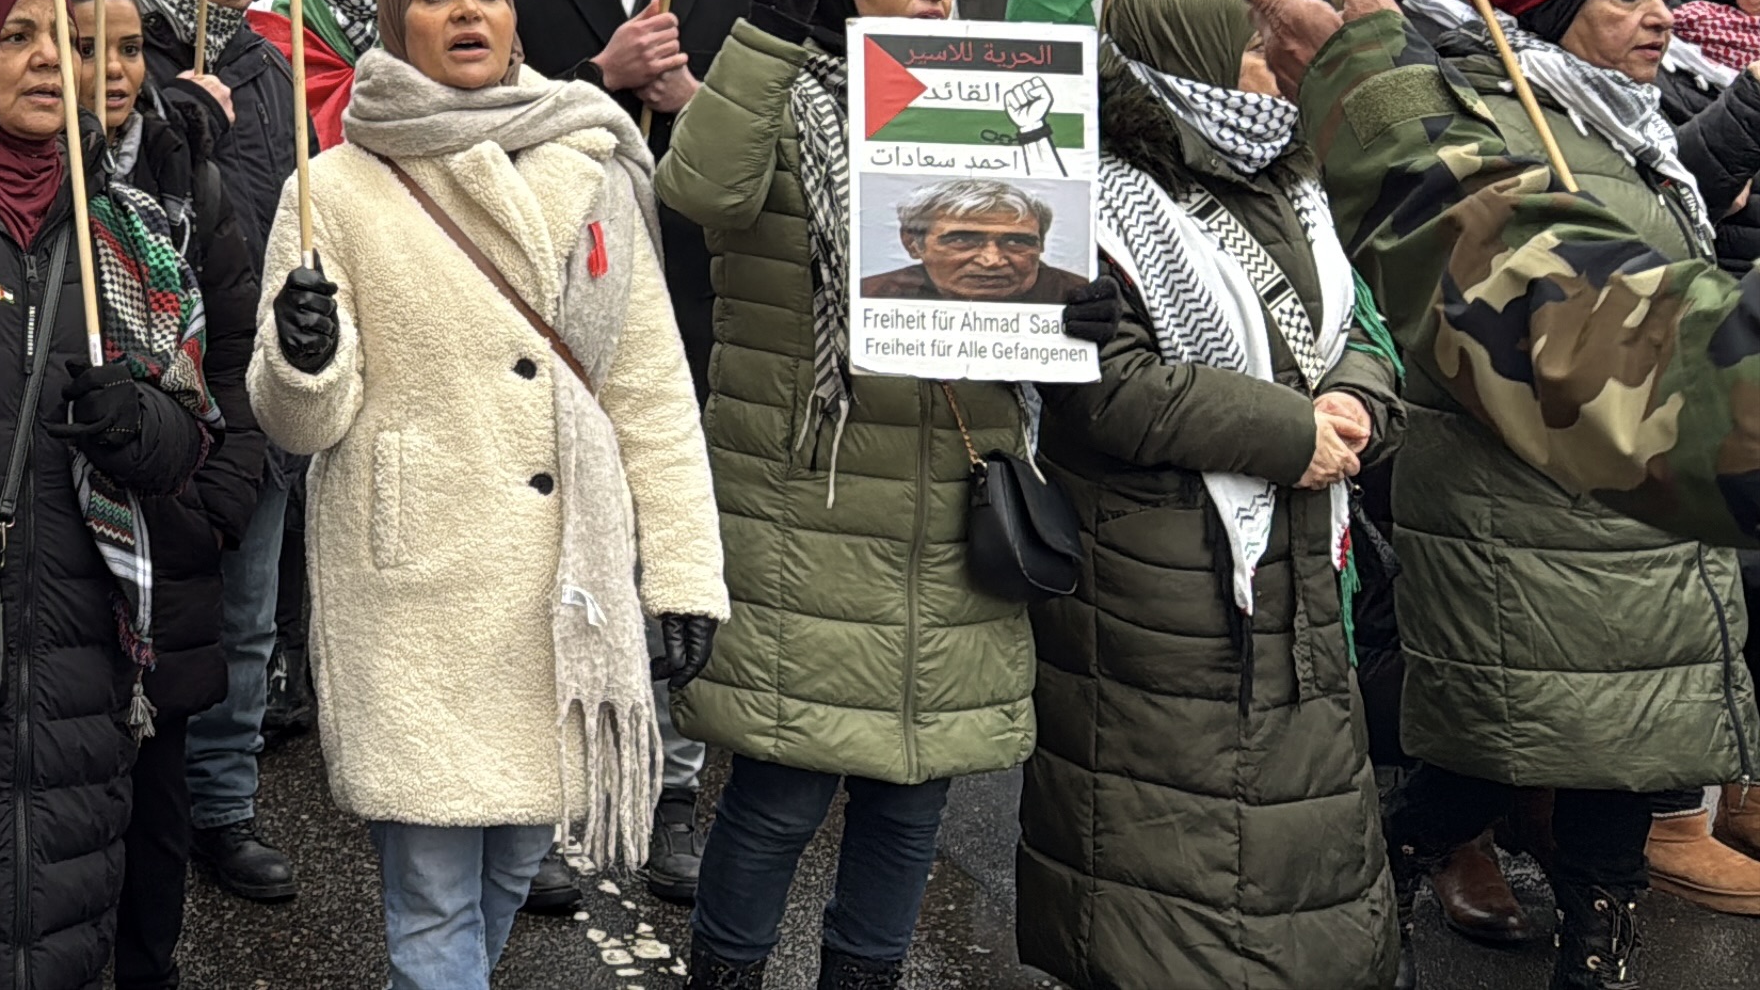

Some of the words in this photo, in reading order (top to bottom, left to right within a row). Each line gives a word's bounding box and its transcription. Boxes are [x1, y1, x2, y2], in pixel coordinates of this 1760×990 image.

[984, 45, 1052, 68] الحرية
[923, 81, 1000, 103] القائد
[870, 146, 955, 169] سعادات
[965, 151, 1018, 171] احمد
[863, 308, 926, 330] Freiheit
[932, 310, 955, 331] für
[960, 312, 1020, 333] Ahmad
[1029, 314, 1067, 335] Saa
[865, 337, 926, 357] Freiheit
[931, 340, 952, 357] für
[957, 341, 987, 359] Alle
[992, 342, 1088, 365] Gefangenen
